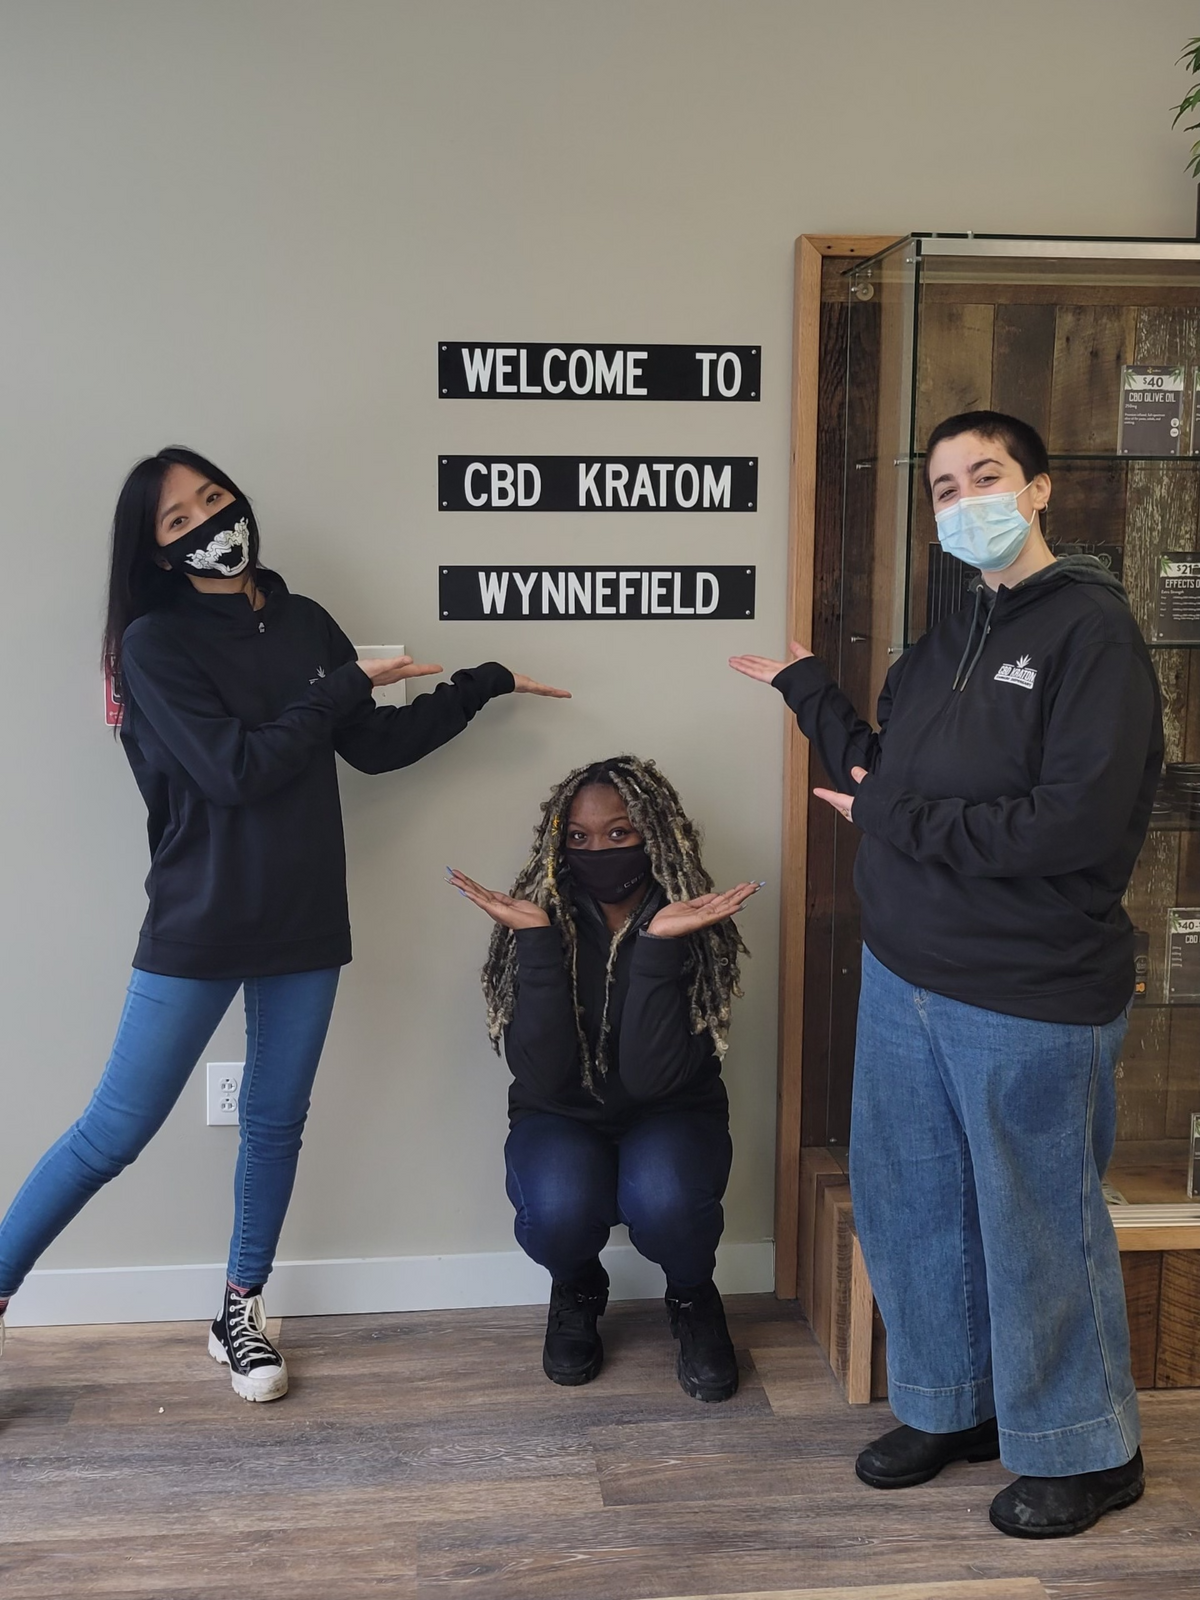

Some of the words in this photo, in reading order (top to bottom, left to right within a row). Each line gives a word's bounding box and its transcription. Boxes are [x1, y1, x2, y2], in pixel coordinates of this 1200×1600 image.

[461, 348, 648, 396] WELCOME
[695, 352, 742, 398] TO
[1143, 376, 1164, 388] $40
[1129, 392, 1143, 403] CBD
[1144, 392, 1164, 403] OLIVE
[1165, 392, 1176, 403] OIL
[464, 462, 542, 508] CBD
[578, 463, 732, 508] KRATOM
[1165, 579, 1195, 589] EFFECTS
[478, 571, 720, 615] WYNNEFIELD
[1185, 935, 1198, 944] CBD
